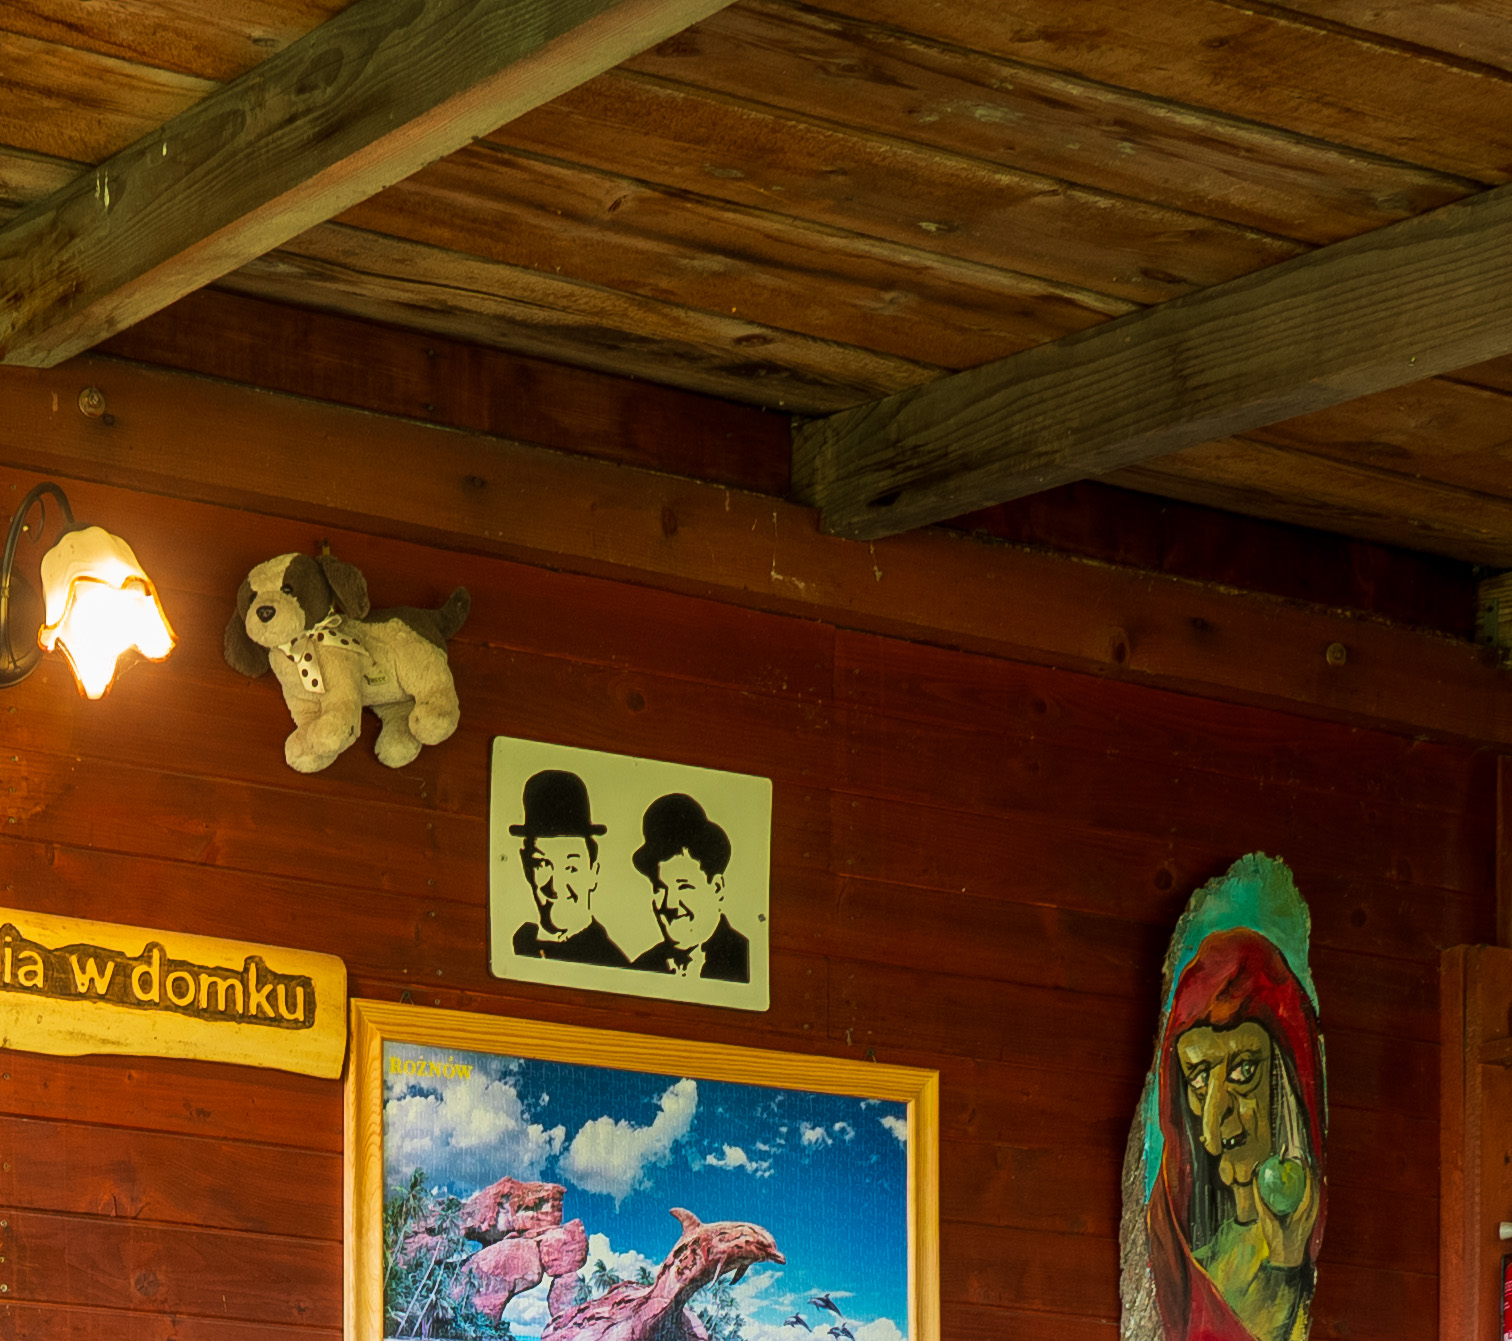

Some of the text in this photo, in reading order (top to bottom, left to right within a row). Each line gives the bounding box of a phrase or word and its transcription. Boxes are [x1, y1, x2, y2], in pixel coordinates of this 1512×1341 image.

[71, 954, 115, 995] w
[132, 948, 305, 1022] domku
[389, 1054, 473, 1080] ROŻNÓW
